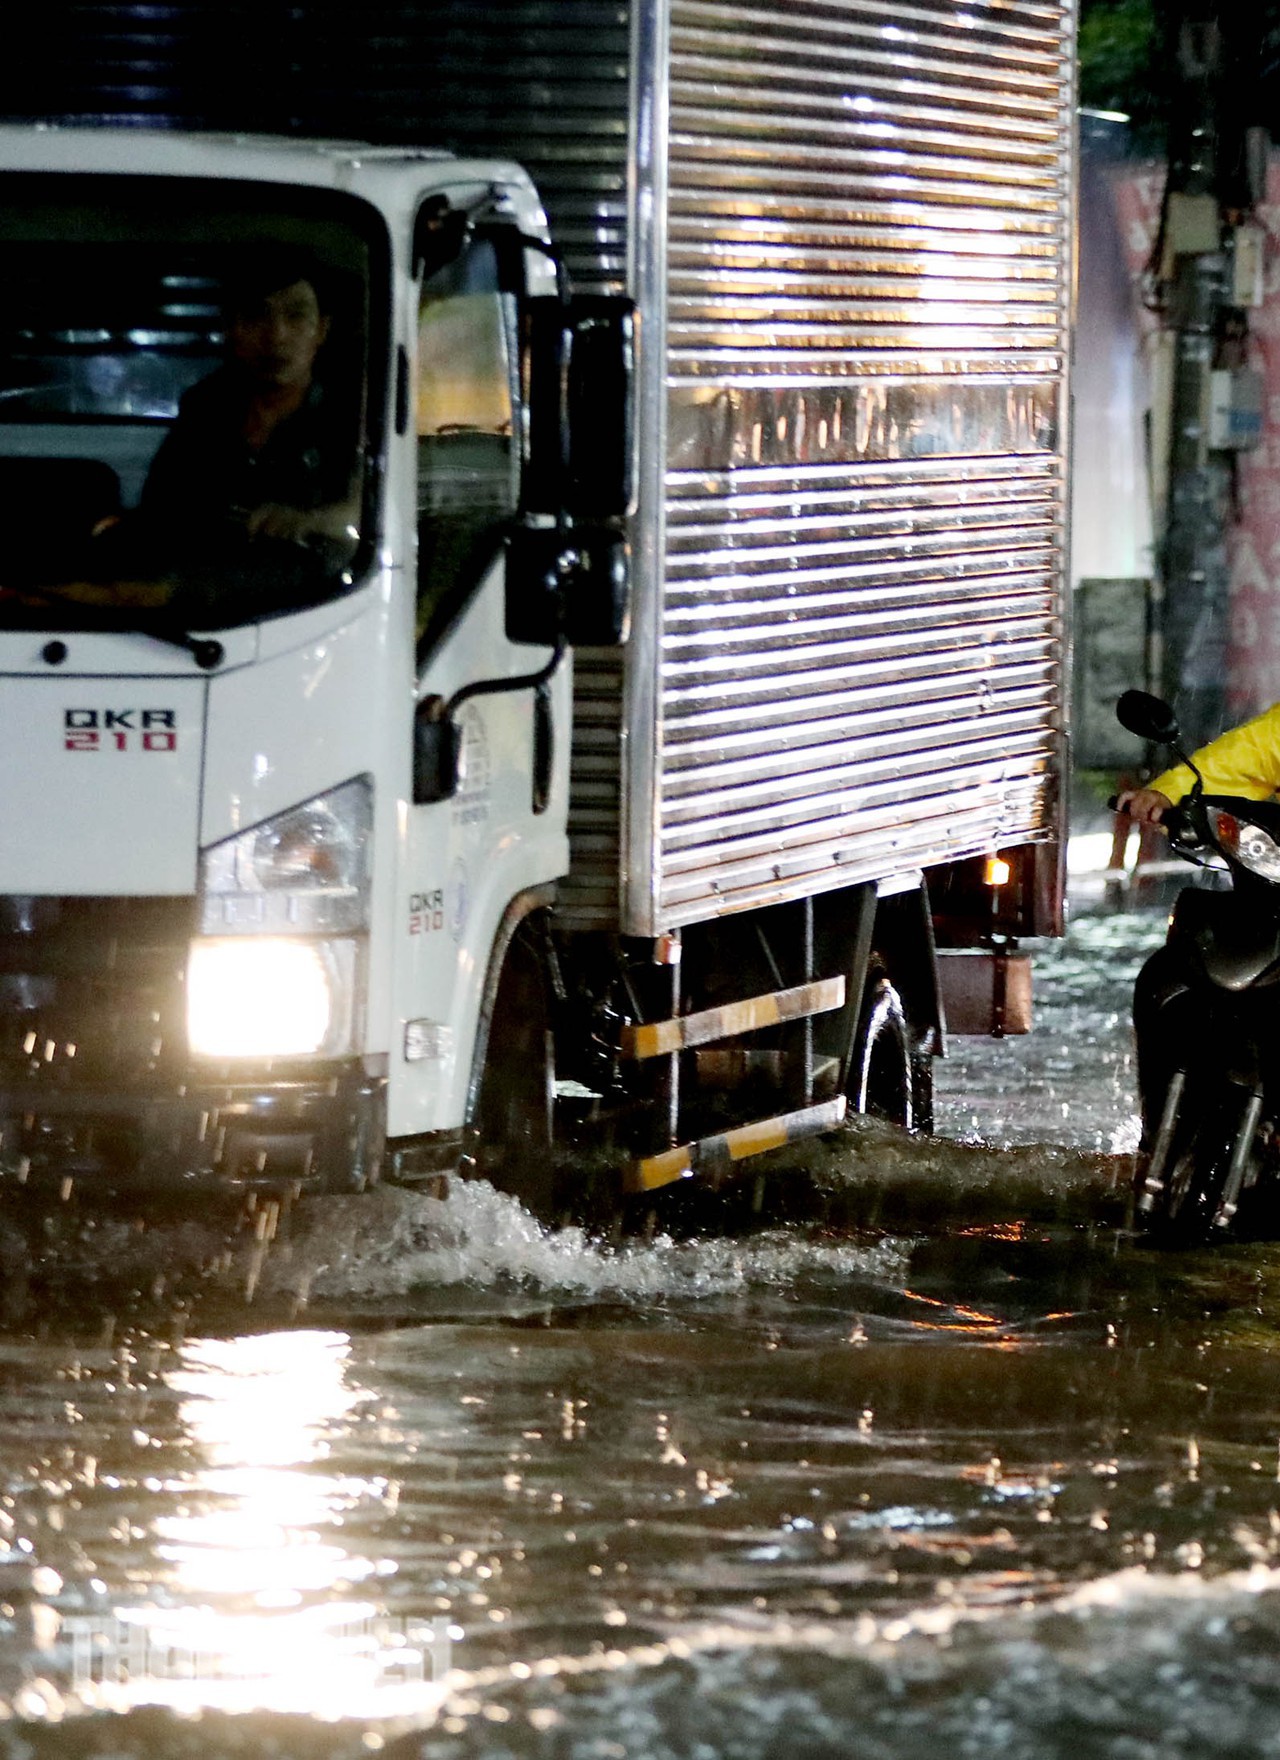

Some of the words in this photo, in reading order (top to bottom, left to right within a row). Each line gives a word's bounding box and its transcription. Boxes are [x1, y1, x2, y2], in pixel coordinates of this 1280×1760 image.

[65, 709, 175, 729] QKR
[65, 732, 176, 751] 210
[409, 889, 443, 912] QKR
[409, 911, 443, 935] 210
